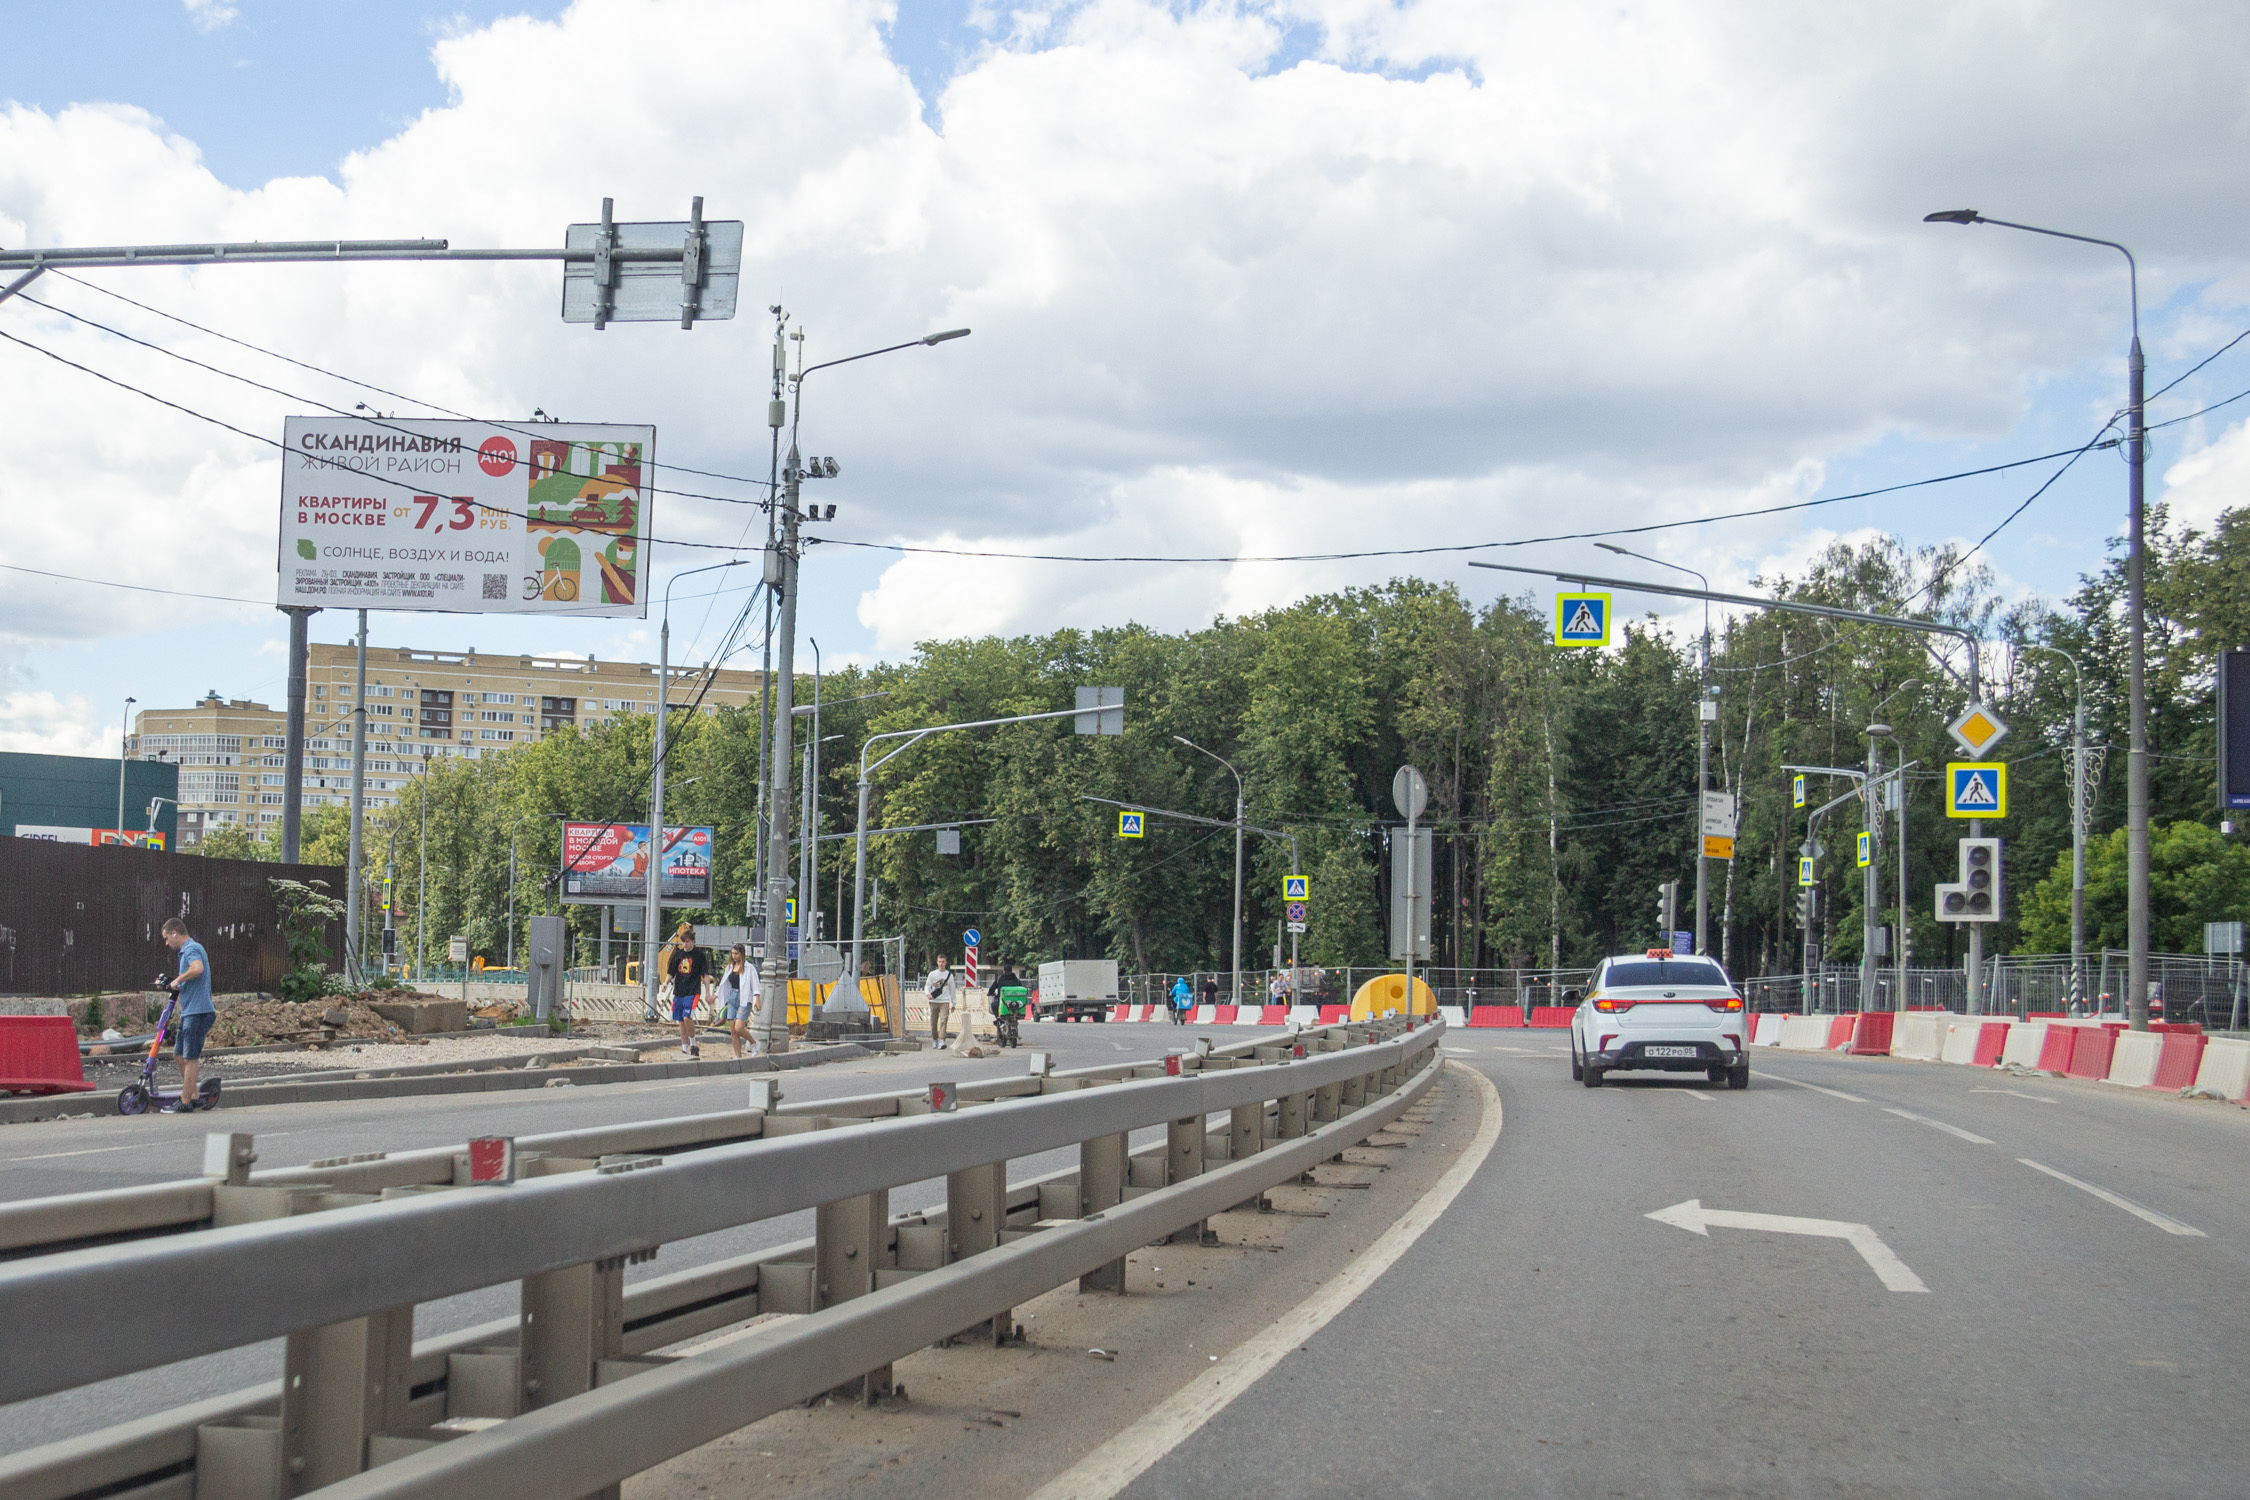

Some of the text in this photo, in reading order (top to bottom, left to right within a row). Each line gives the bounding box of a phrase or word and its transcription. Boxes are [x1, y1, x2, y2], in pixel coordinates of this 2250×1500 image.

[301, 433, 462, 454] СКАНДИНАВИЯ
[300, 454, 460, 474] ЖИВОЙ РАЙОН
[298, 495, 387, 510] КВАРТИРЫ
[297, 511, 386, 526] В МОСКВЕ
[393, 495, 475, 535] ОТ 7,3
[480, 507, 510, 518] МЛН
[479, 519, 511, 530] РУБ.
[323, 546, 509, 563] СОЛНЦЕ, ВОЗДУХ И ВОДА!
[669, 867, 706, 875] ИПОТЕКА
